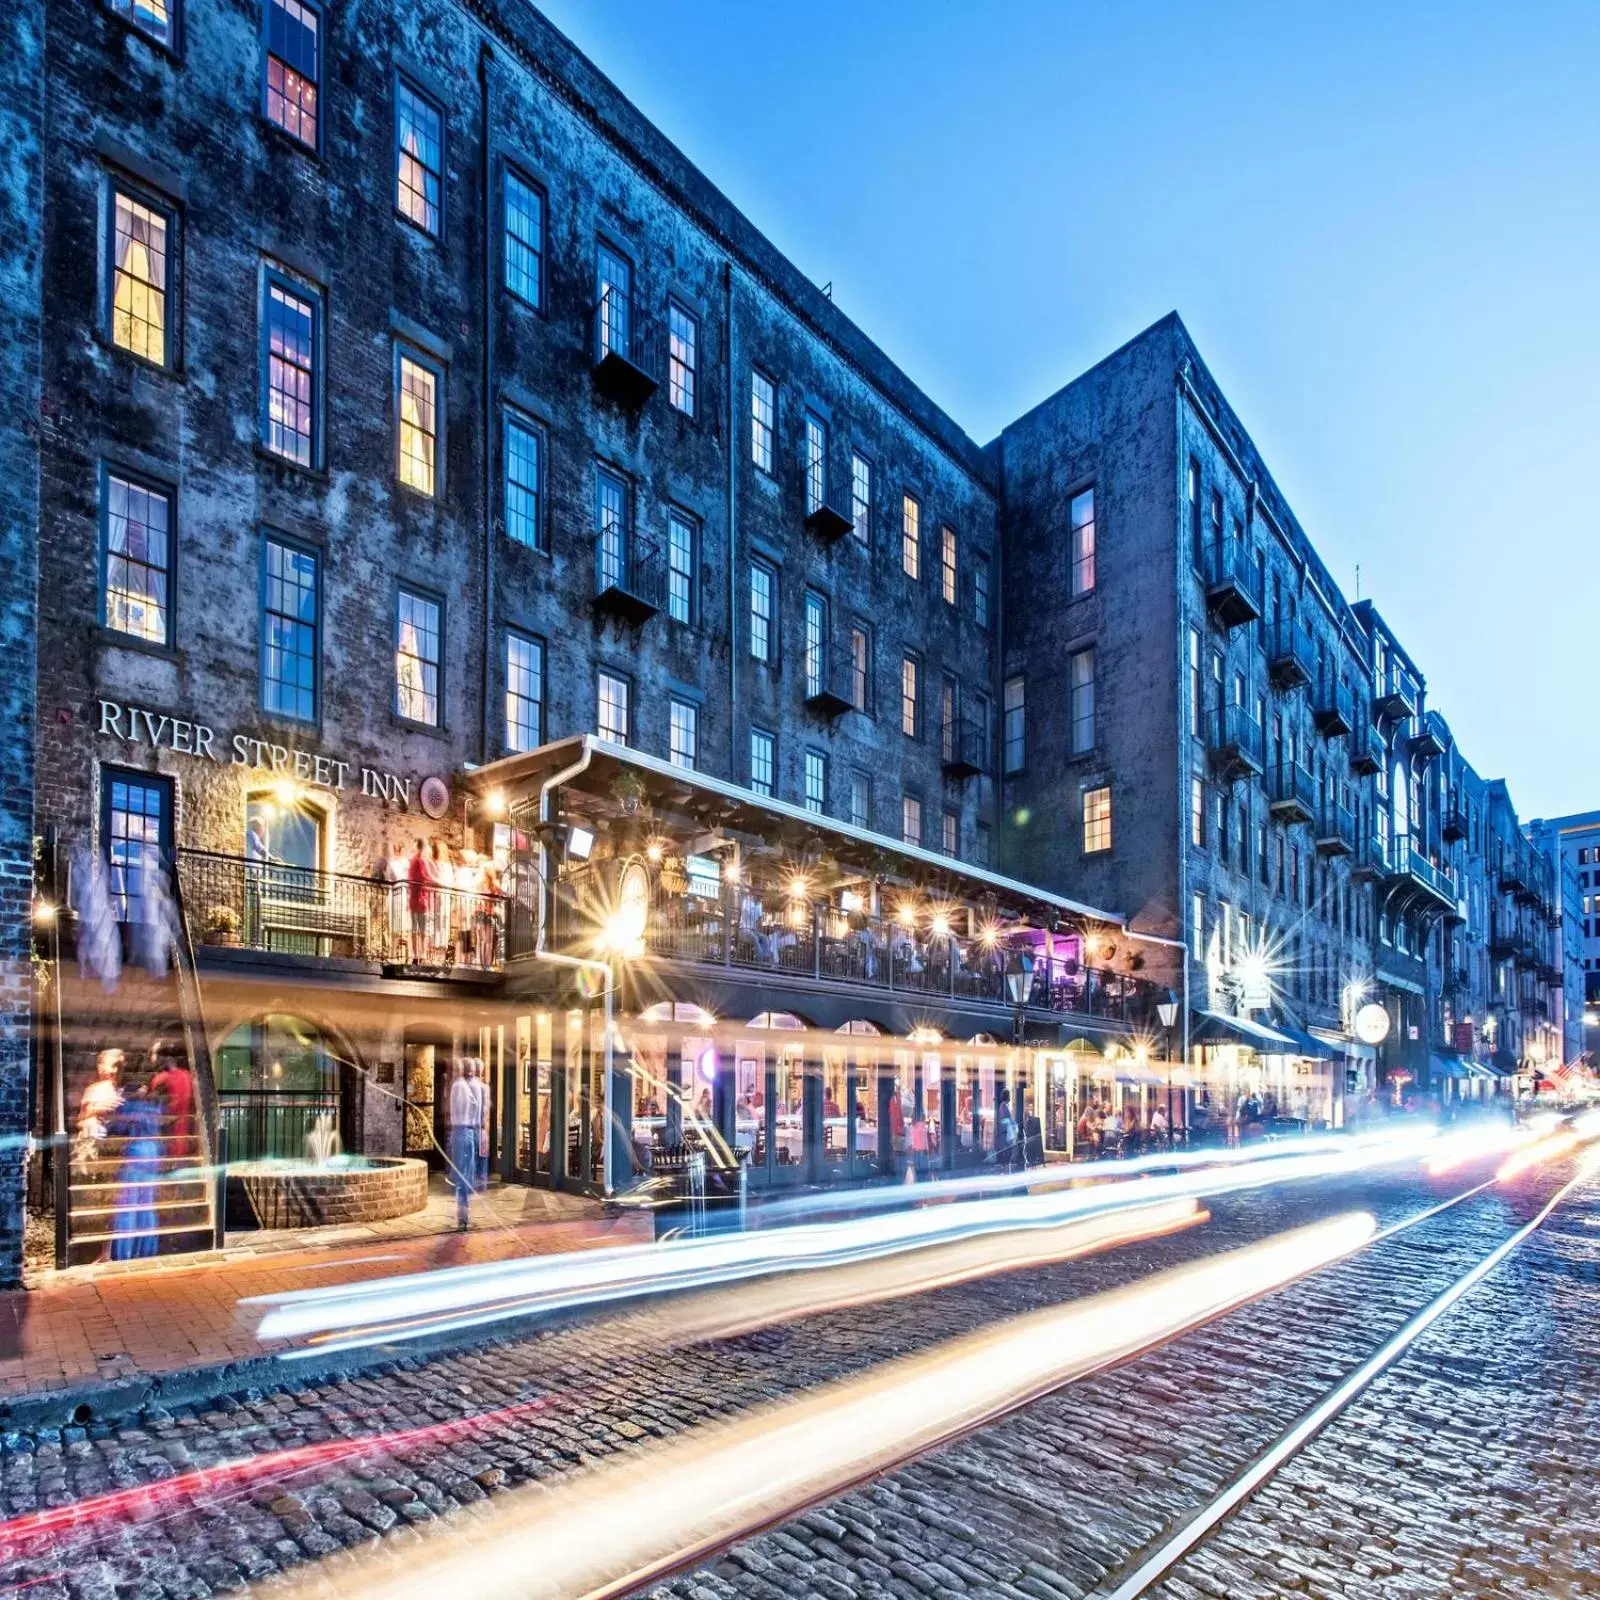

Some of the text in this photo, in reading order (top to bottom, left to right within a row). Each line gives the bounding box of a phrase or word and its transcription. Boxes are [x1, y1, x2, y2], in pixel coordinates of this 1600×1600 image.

[99, 700, 411, 807] RIVER STREET INN
